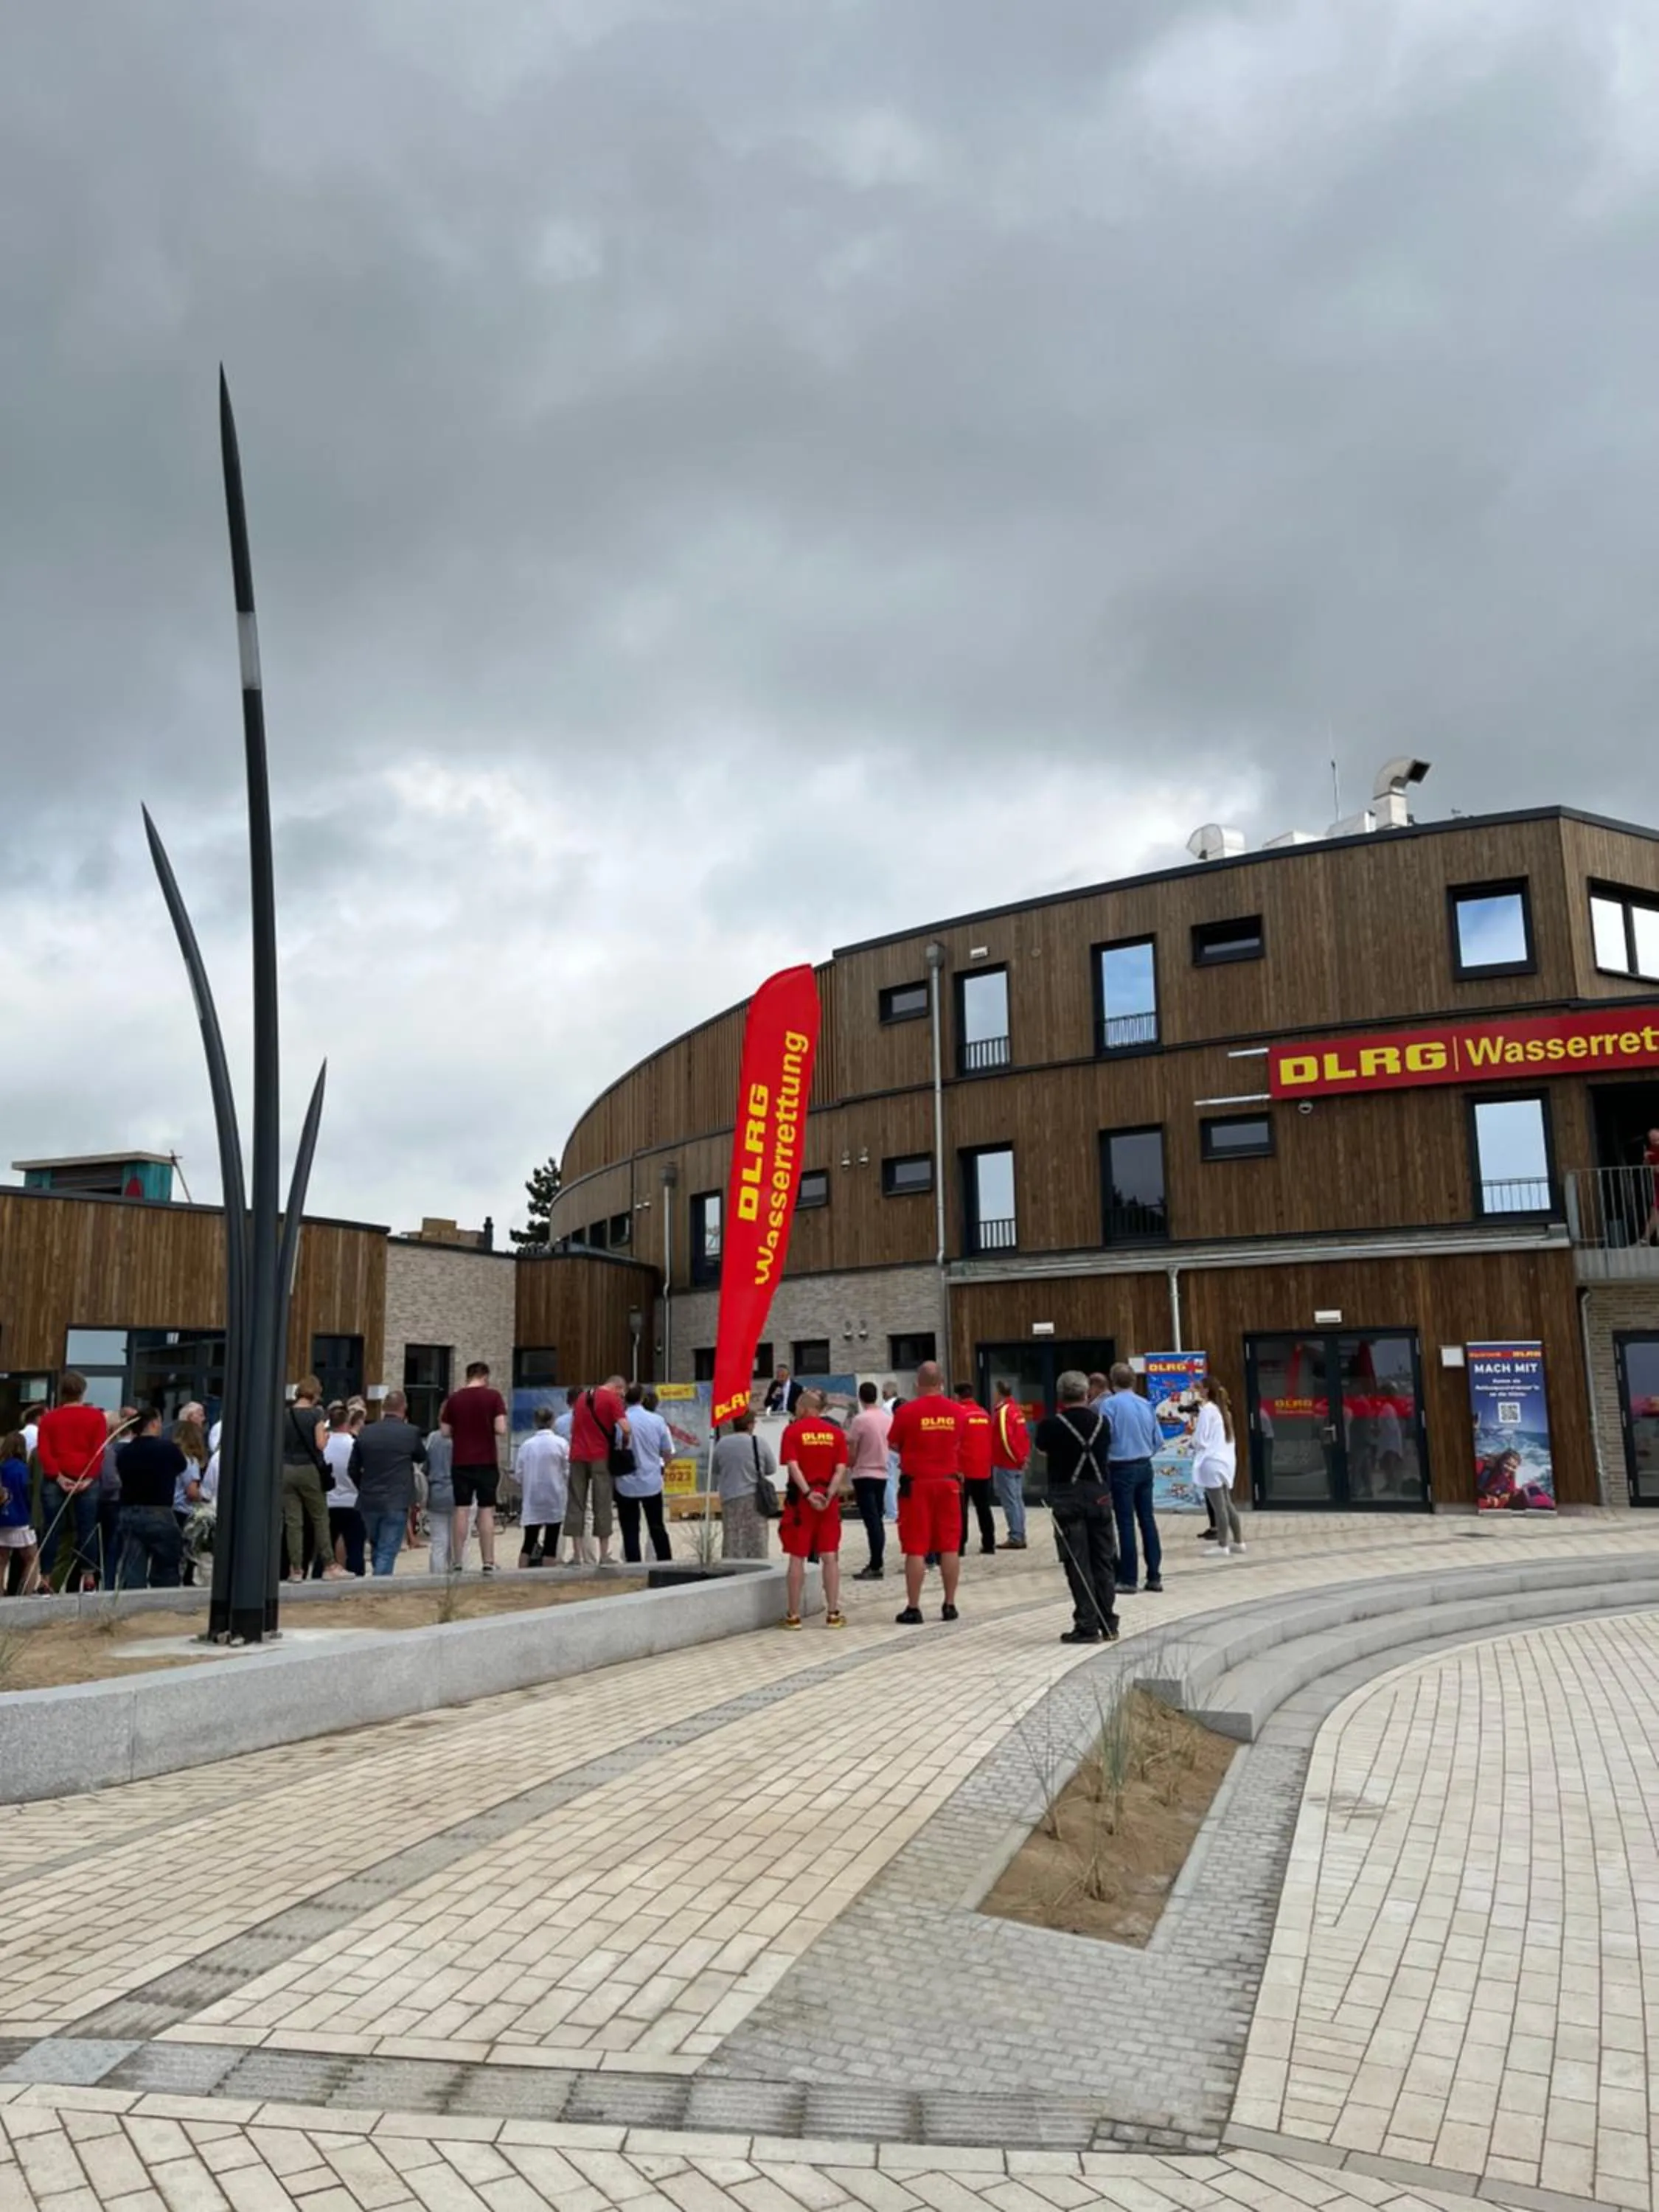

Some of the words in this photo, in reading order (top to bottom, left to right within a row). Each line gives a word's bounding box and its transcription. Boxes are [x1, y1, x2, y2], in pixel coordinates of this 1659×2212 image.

[1279, 1042, 1447, 1086] DLRG
[1464, 1026, 1659, 1066] Wasserret
[738, 1082, 769, 1222] DLRG
[754, 1030, 810, 1285] Wasserrettung
[1148, 1362, 1186, 1371] DLRG
[1474, 1362, 1512, 1373] MACH
[1514, 1362, 1538, 1373] MIT
[920, 1416, 956, 1425] DLRG
